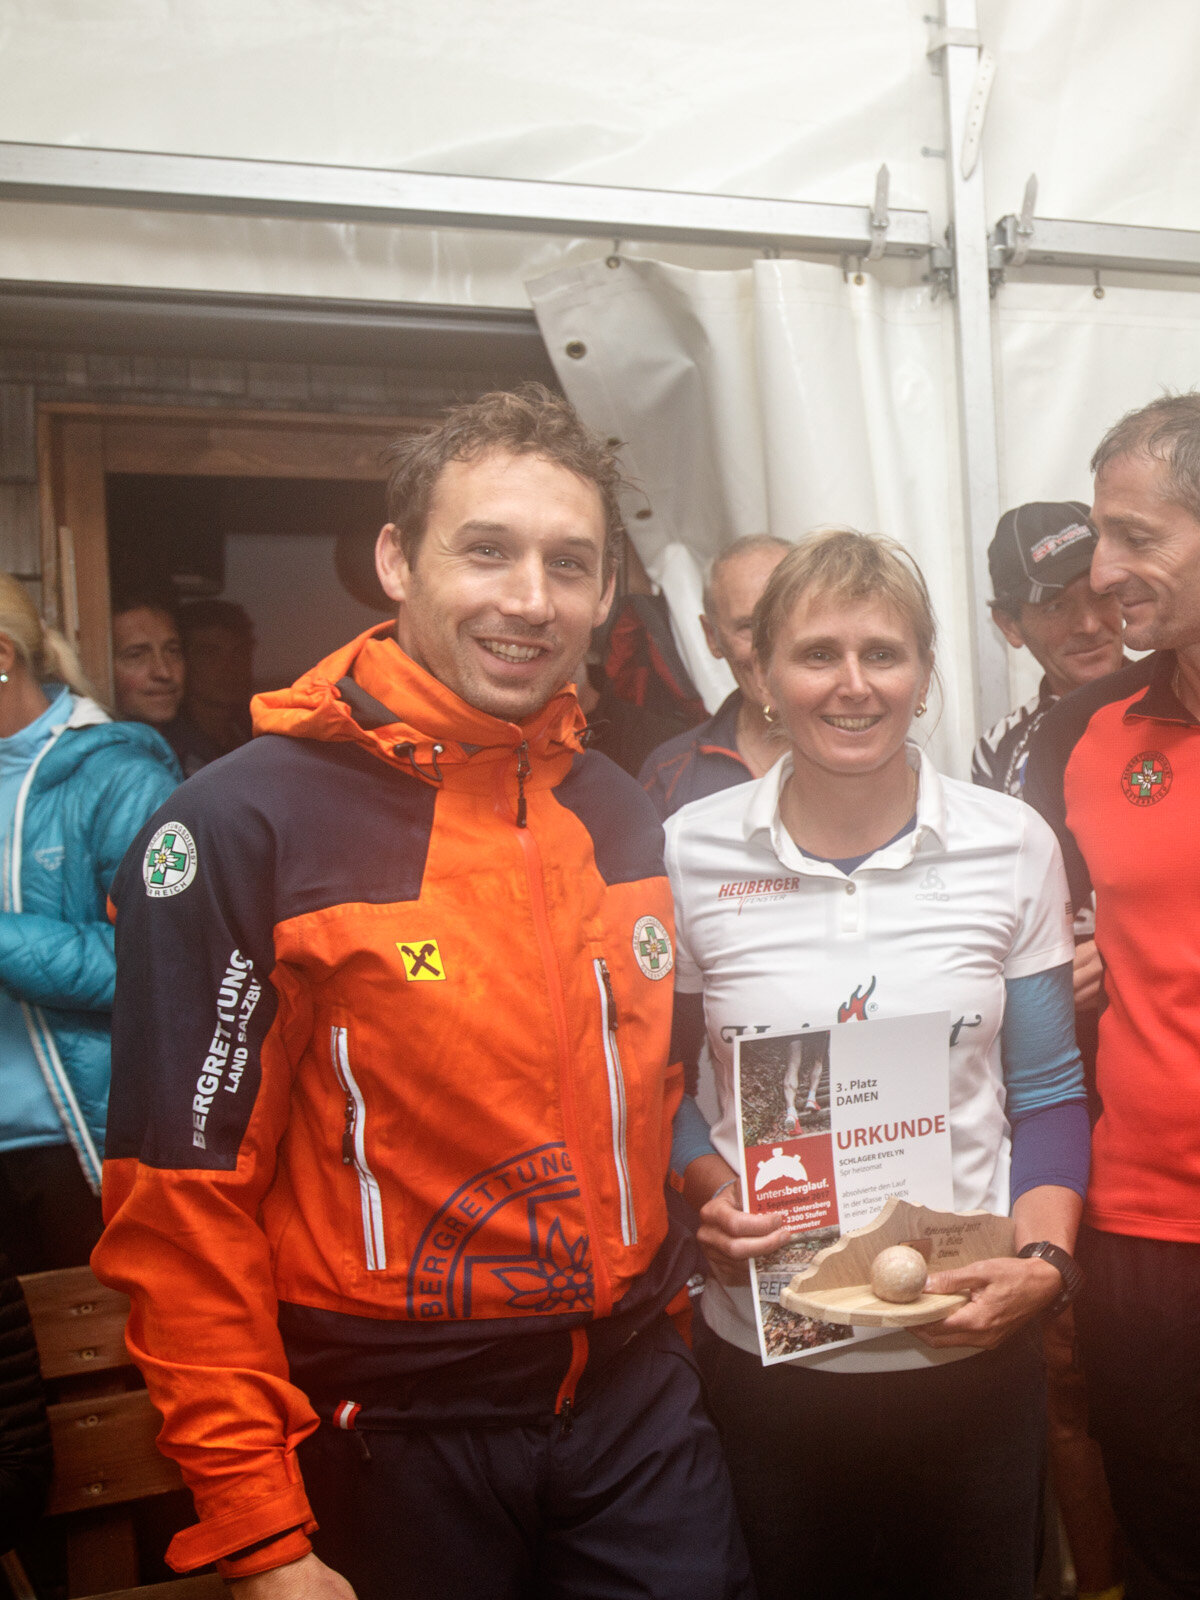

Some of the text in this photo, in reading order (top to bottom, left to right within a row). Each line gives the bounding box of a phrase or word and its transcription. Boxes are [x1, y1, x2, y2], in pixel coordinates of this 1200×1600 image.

[718, 877, 801, 898] HEUBERGER
[192, 949, 254, 1150] BERGRETTUNG
[224, 1047, 249, 1094] LAND
[850, 1079, 878, 1091] Platz
[836, 1091, 880, 1107] DAMEN
[837, 1114, 946, 1150] URKUNDE
[877, 1148, 905, 1160] EVELYN
[756, 1178, 830, 1201] untersberglauf.
[420, 1151, 573, 1318] BERGRETTUNG
